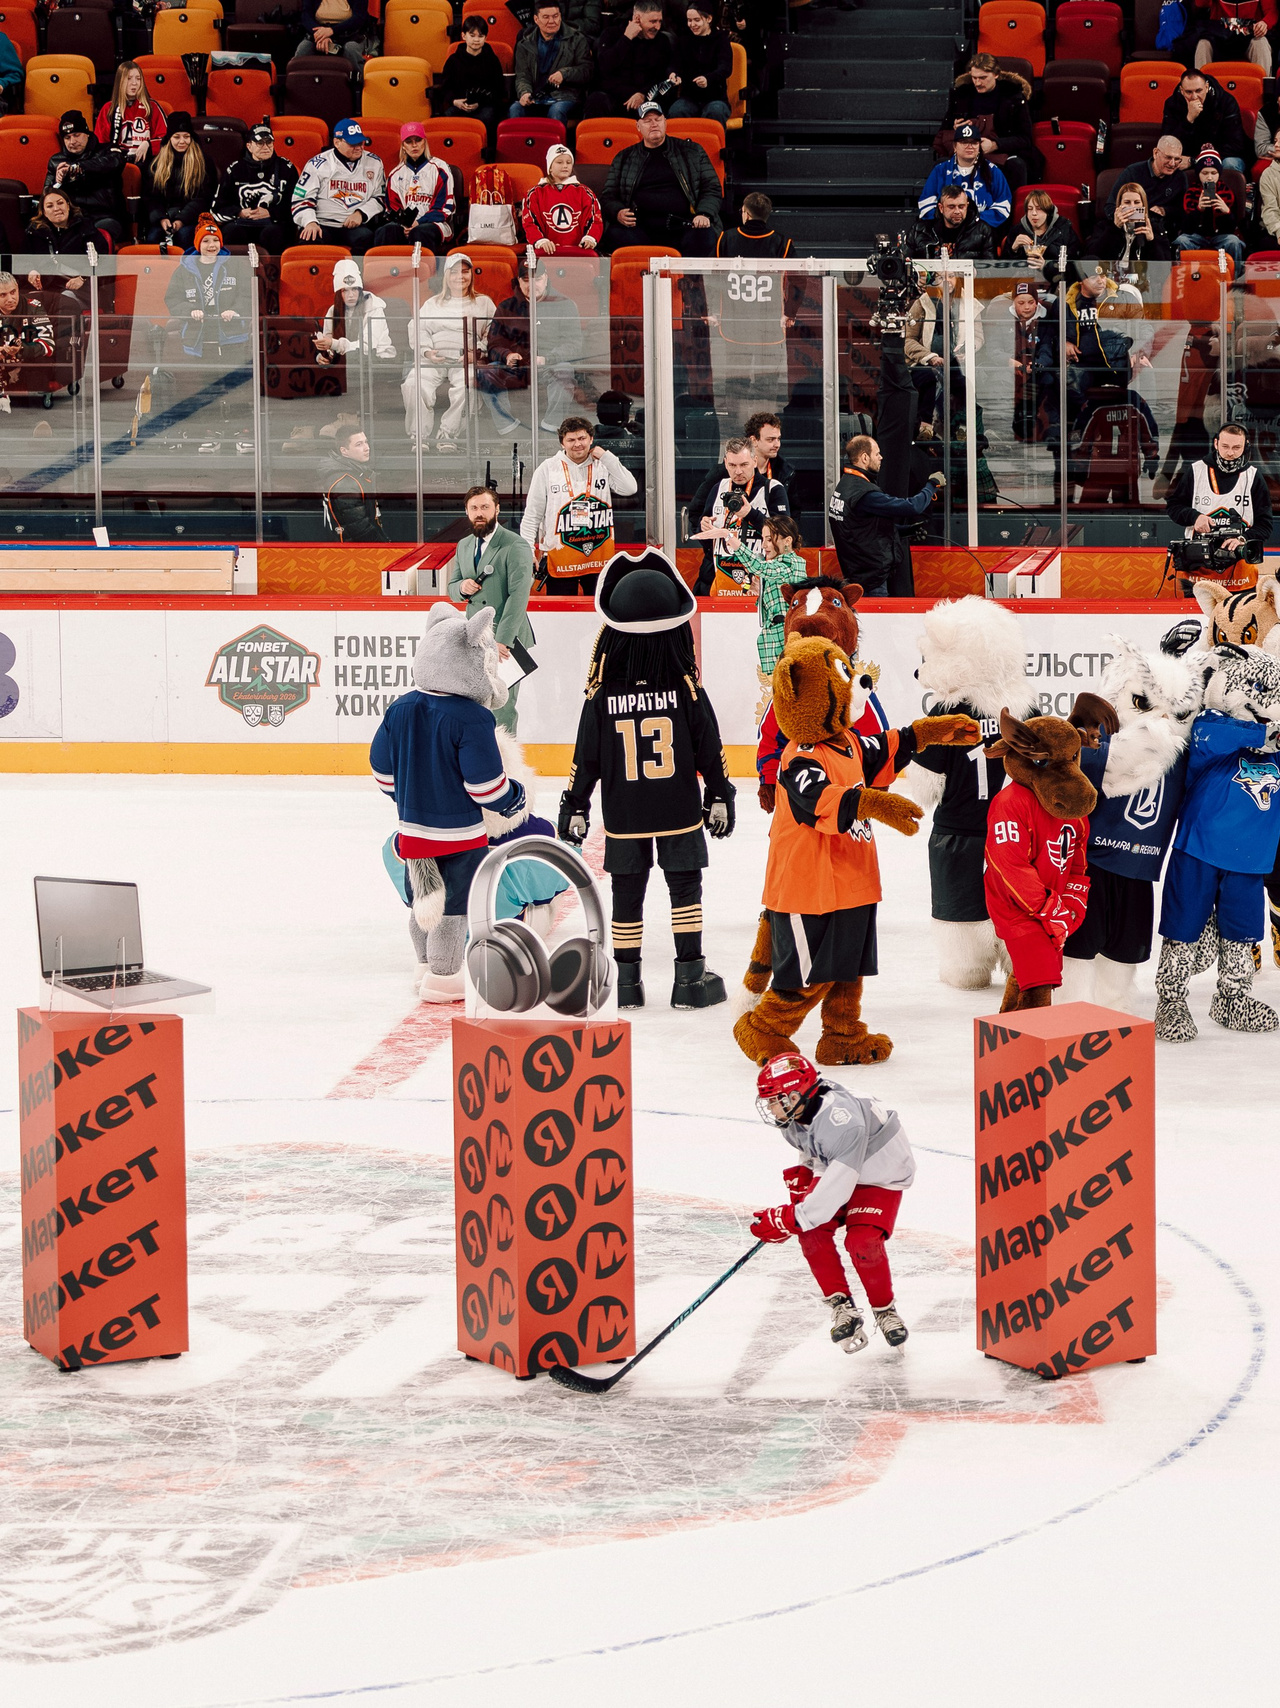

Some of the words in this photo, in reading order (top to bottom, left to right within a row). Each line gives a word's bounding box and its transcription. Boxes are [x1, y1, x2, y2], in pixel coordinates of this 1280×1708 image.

[330, 180, 367, 194] METALLURG
[727, 272, 773, 302] 332
[595, 479, 606, 490] 49
[1234, 495, 1250, 507] 95
[236, 641, 289, 653] FONBET
[334, 636, 420, 658] FONBET
[210, 655, 252, 683] ALL
[260, 655, 317, 683] STAR
[232, 691, 279, 702] Ekaterinburg
[279, 693, 296, 701] 2026
[607, 691, 678, 715] ПИРАТЫЧ
[615, 717, 675, 781] 13
[795, 767, 827, 793] 27
[994, 821, 1020, 844] 96
[1094, 836, 1131, 851] SAMARA
[1139, 845, 1161, 856] REGION
[783, 1079, 800, 1088] CCM
[22, 1072, 159, 1194] Маркет
[980, 1076, 1133, 1205] Маркет
[23, 1146, 160, 1268] Маркет
[980, 1149, 1134, 1278] Маркет
[25, 1219, 161, 1339] Маркет
[981, 1222, 1134, 1350] Маркет
